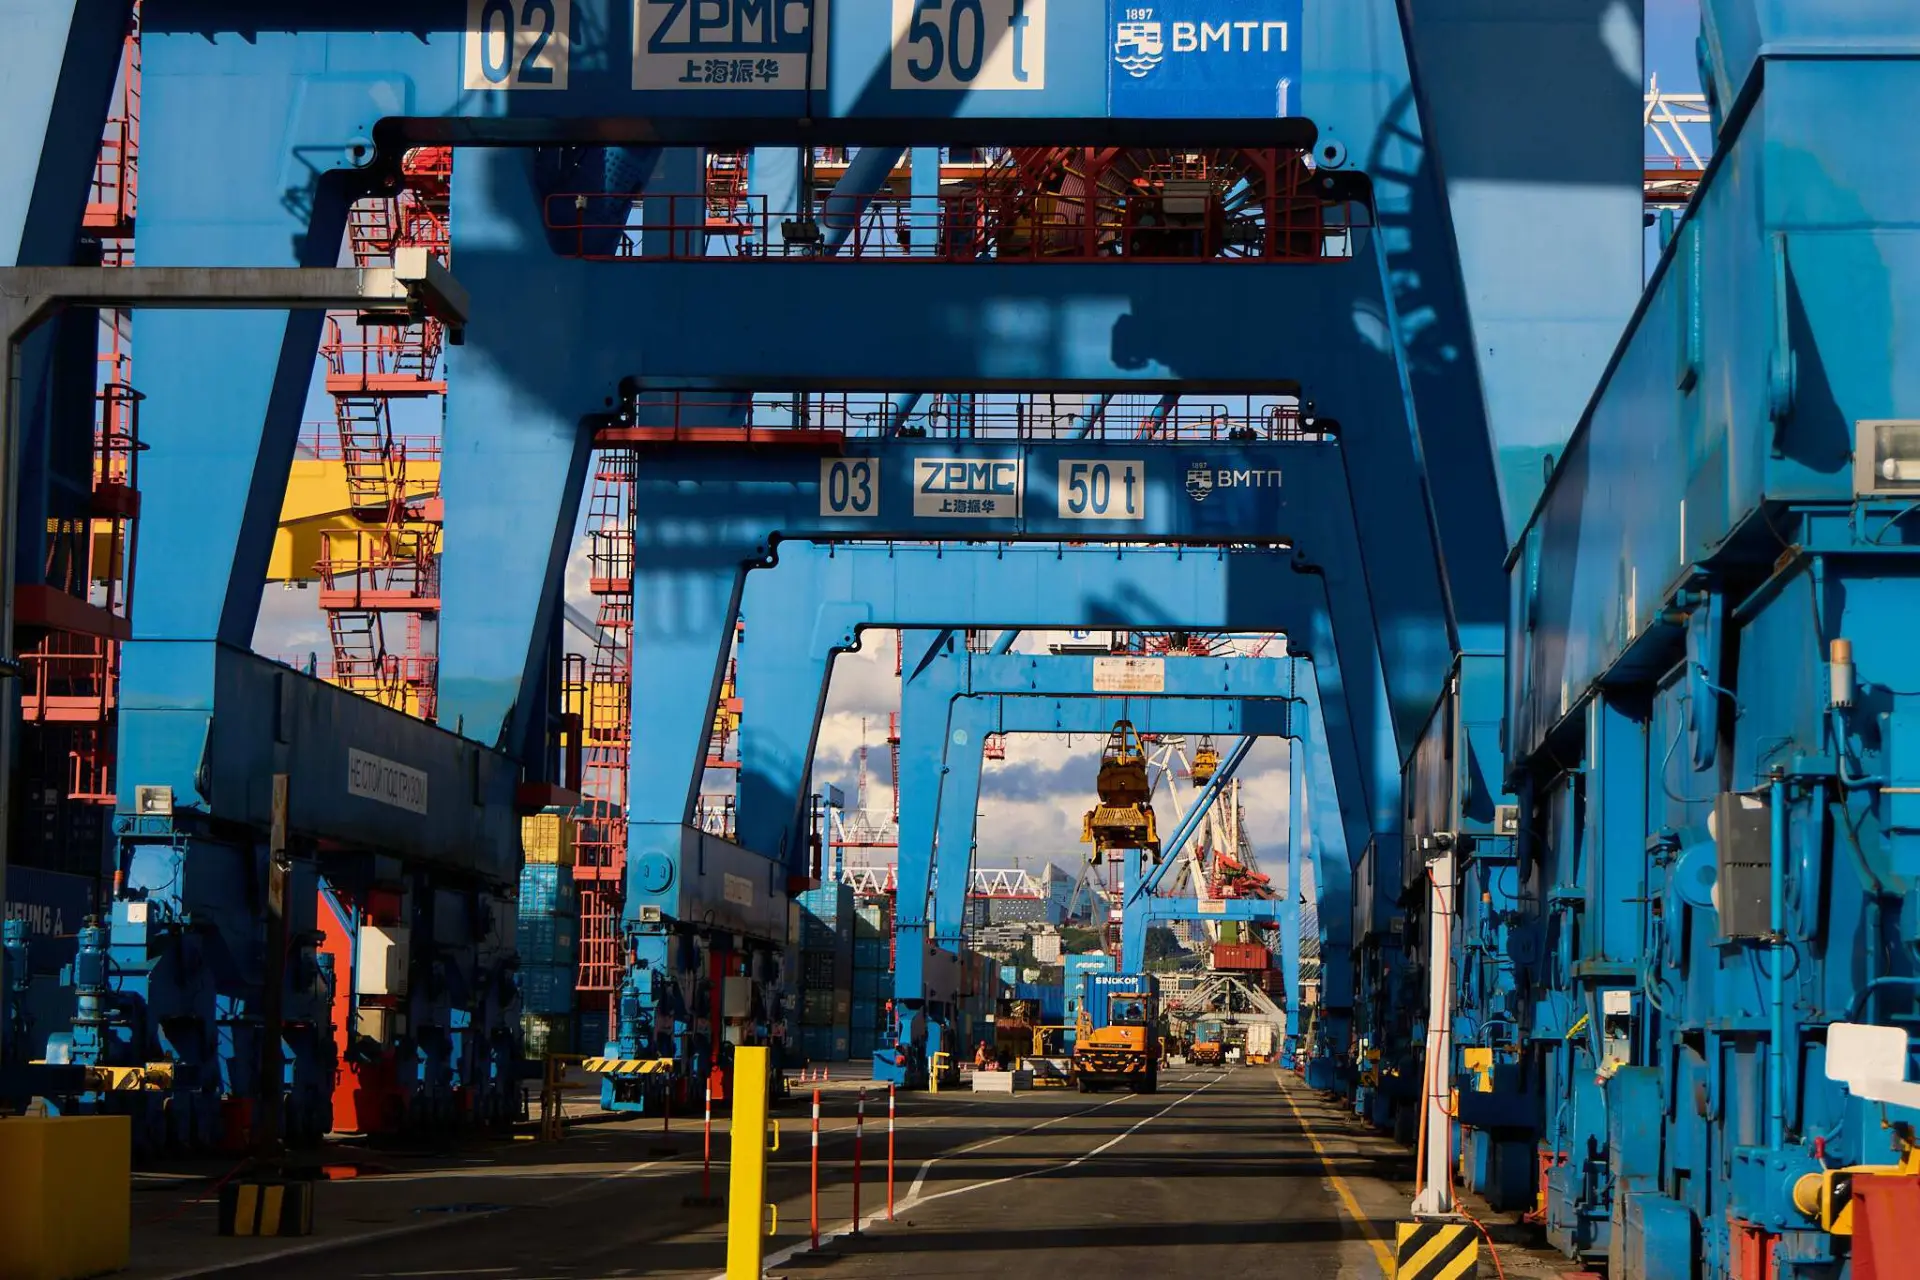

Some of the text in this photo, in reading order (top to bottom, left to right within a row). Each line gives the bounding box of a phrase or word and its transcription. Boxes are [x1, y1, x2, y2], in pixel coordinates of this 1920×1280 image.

[647, 0, 812, 54] ZPMC
[1126, 8, 1153, 20] 1897
[481, 0, 555, 84] 02
[907, 0, 1029, 82] 50 t
[1172, 22, 1288, 52] ВМТП
[678, 58, 779, 83] 上海振华
[829, 461, 872, 512] 03
[921, 462, 1015, 496] ZPMC
[1068, 463, 1136, 514] 50 t
[1218, 470, 1282, 487] ВМТП
[938, 498, 995, 514] 上海振华
